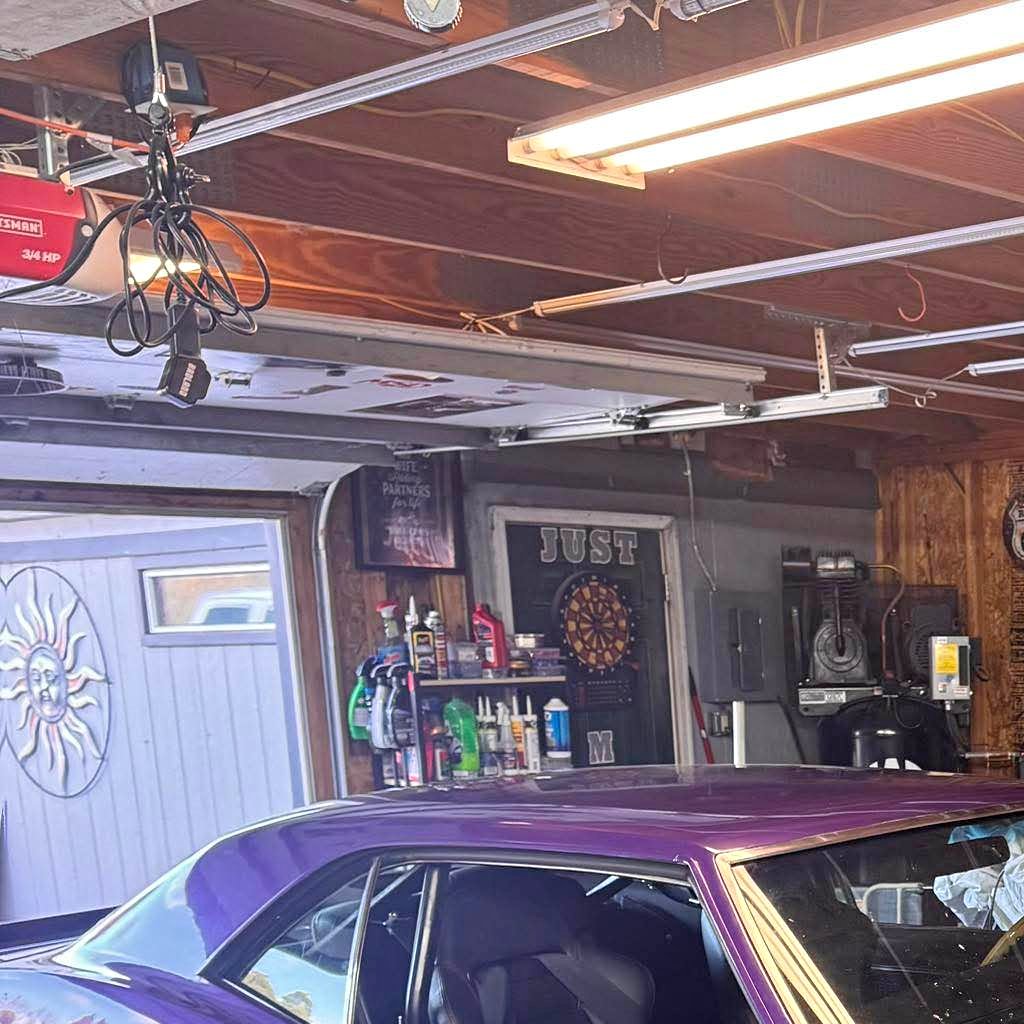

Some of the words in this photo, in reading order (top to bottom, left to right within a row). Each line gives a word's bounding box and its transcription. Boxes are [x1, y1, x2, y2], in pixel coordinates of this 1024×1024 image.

[21, 248, 41, 261] 3/4
[41, 252, 61, 264] HP
[382, 481, 431, 498] PARTNERS
[541, 527, 638, 565] JUST
